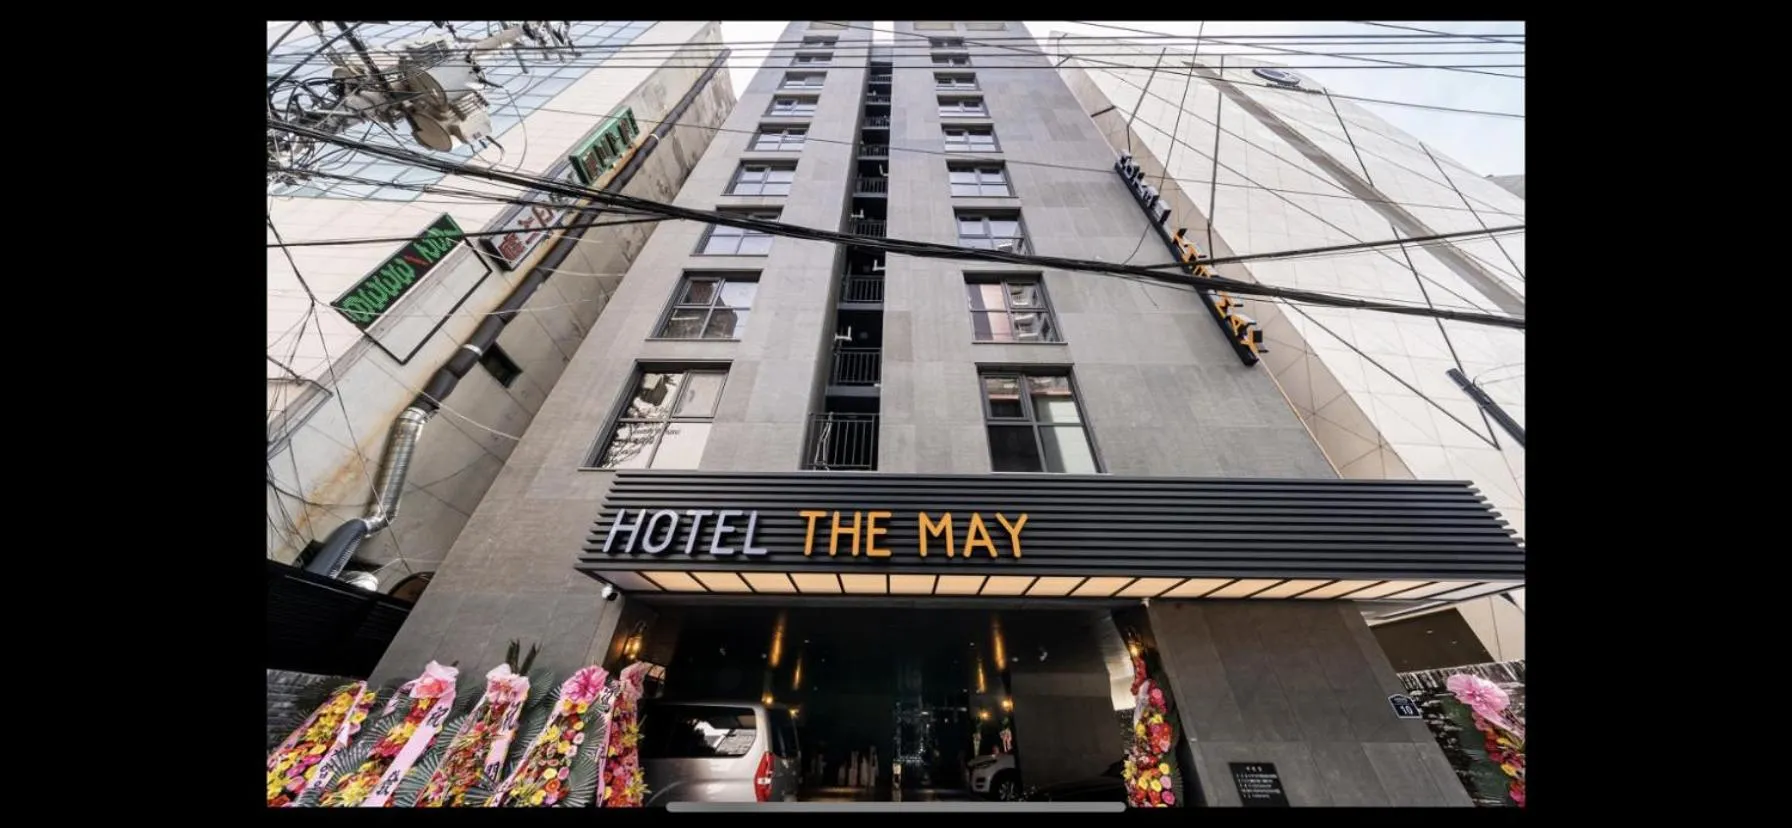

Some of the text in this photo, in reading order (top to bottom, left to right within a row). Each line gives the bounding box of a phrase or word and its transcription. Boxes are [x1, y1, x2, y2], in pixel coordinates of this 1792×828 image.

[602, 509, 1029, 558] HOTEL THE MAY
[1400, 705, 1413, 715] 10
